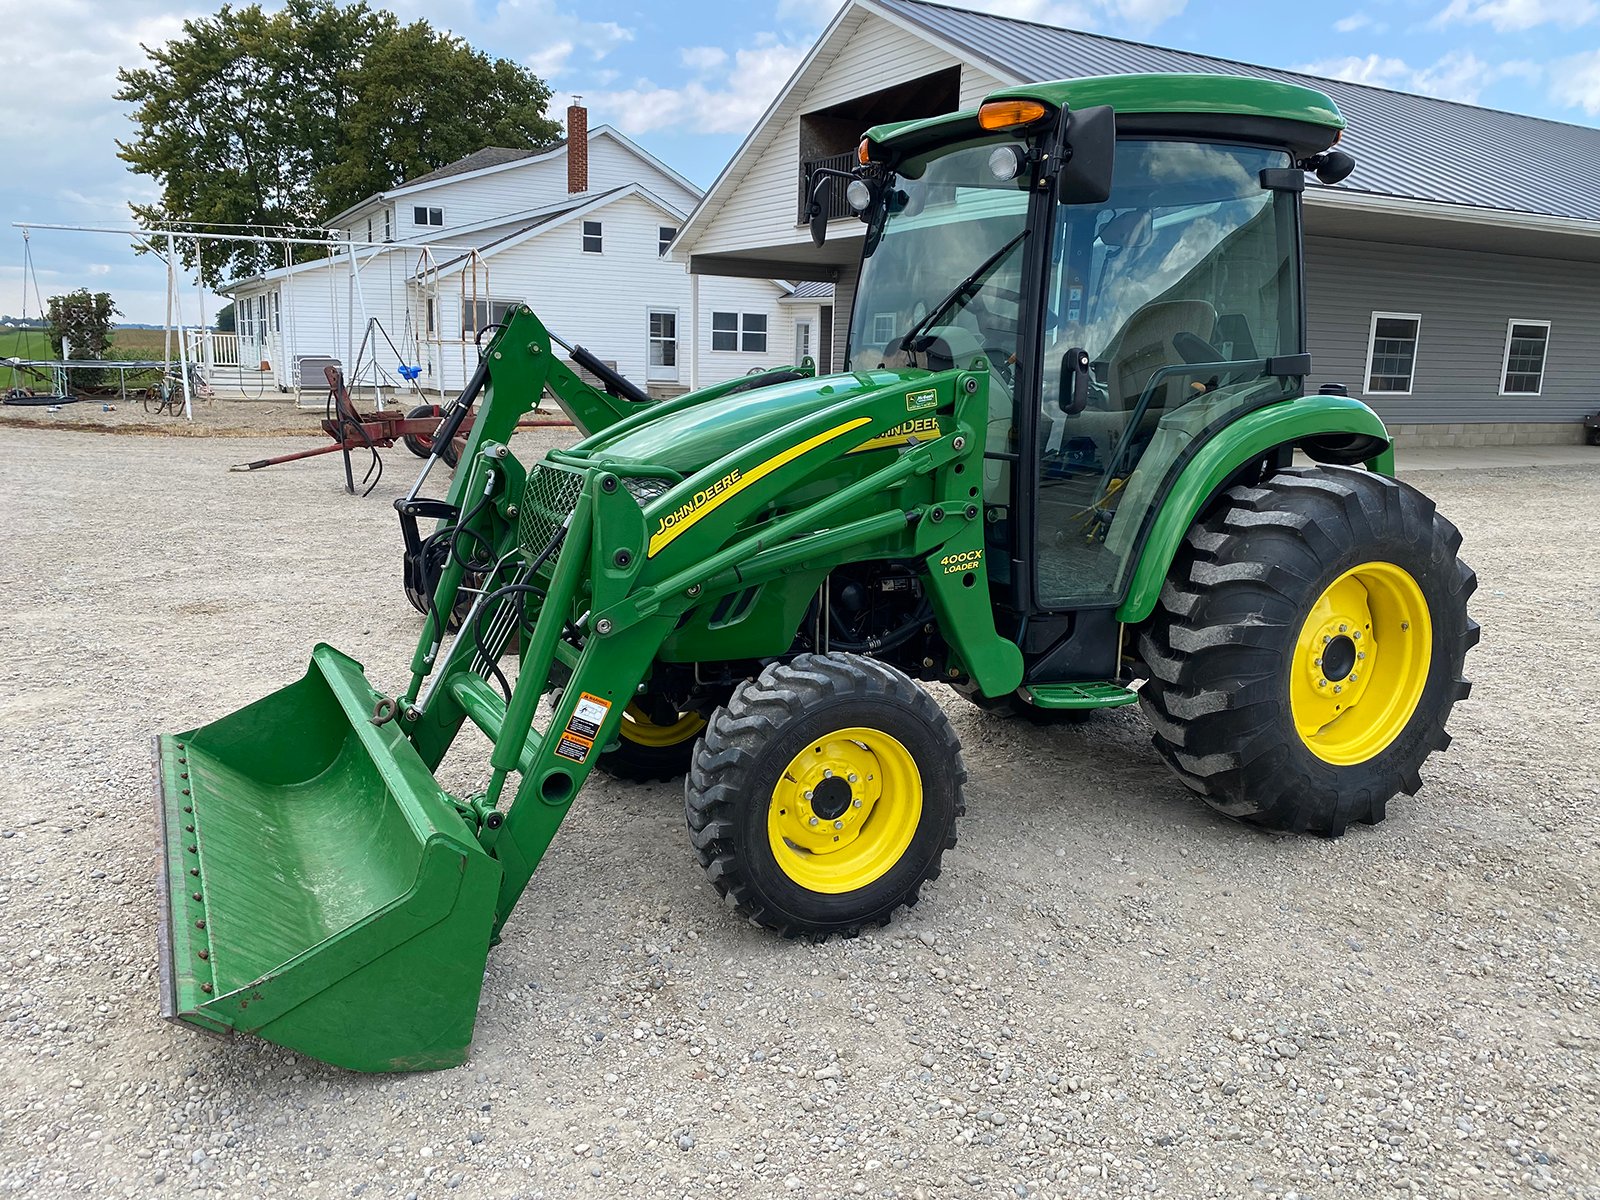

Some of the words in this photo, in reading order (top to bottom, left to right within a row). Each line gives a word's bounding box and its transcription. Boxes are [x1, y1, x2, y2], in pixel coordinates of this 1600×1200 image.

[902, 417, 940, 434] DEER
[656, 500, 694, 535] JOHN
[692, 468, 742, 509] DEERE
[940, 549, 983, 565] 400CX
[944, 561, 979, 574] LOADER
